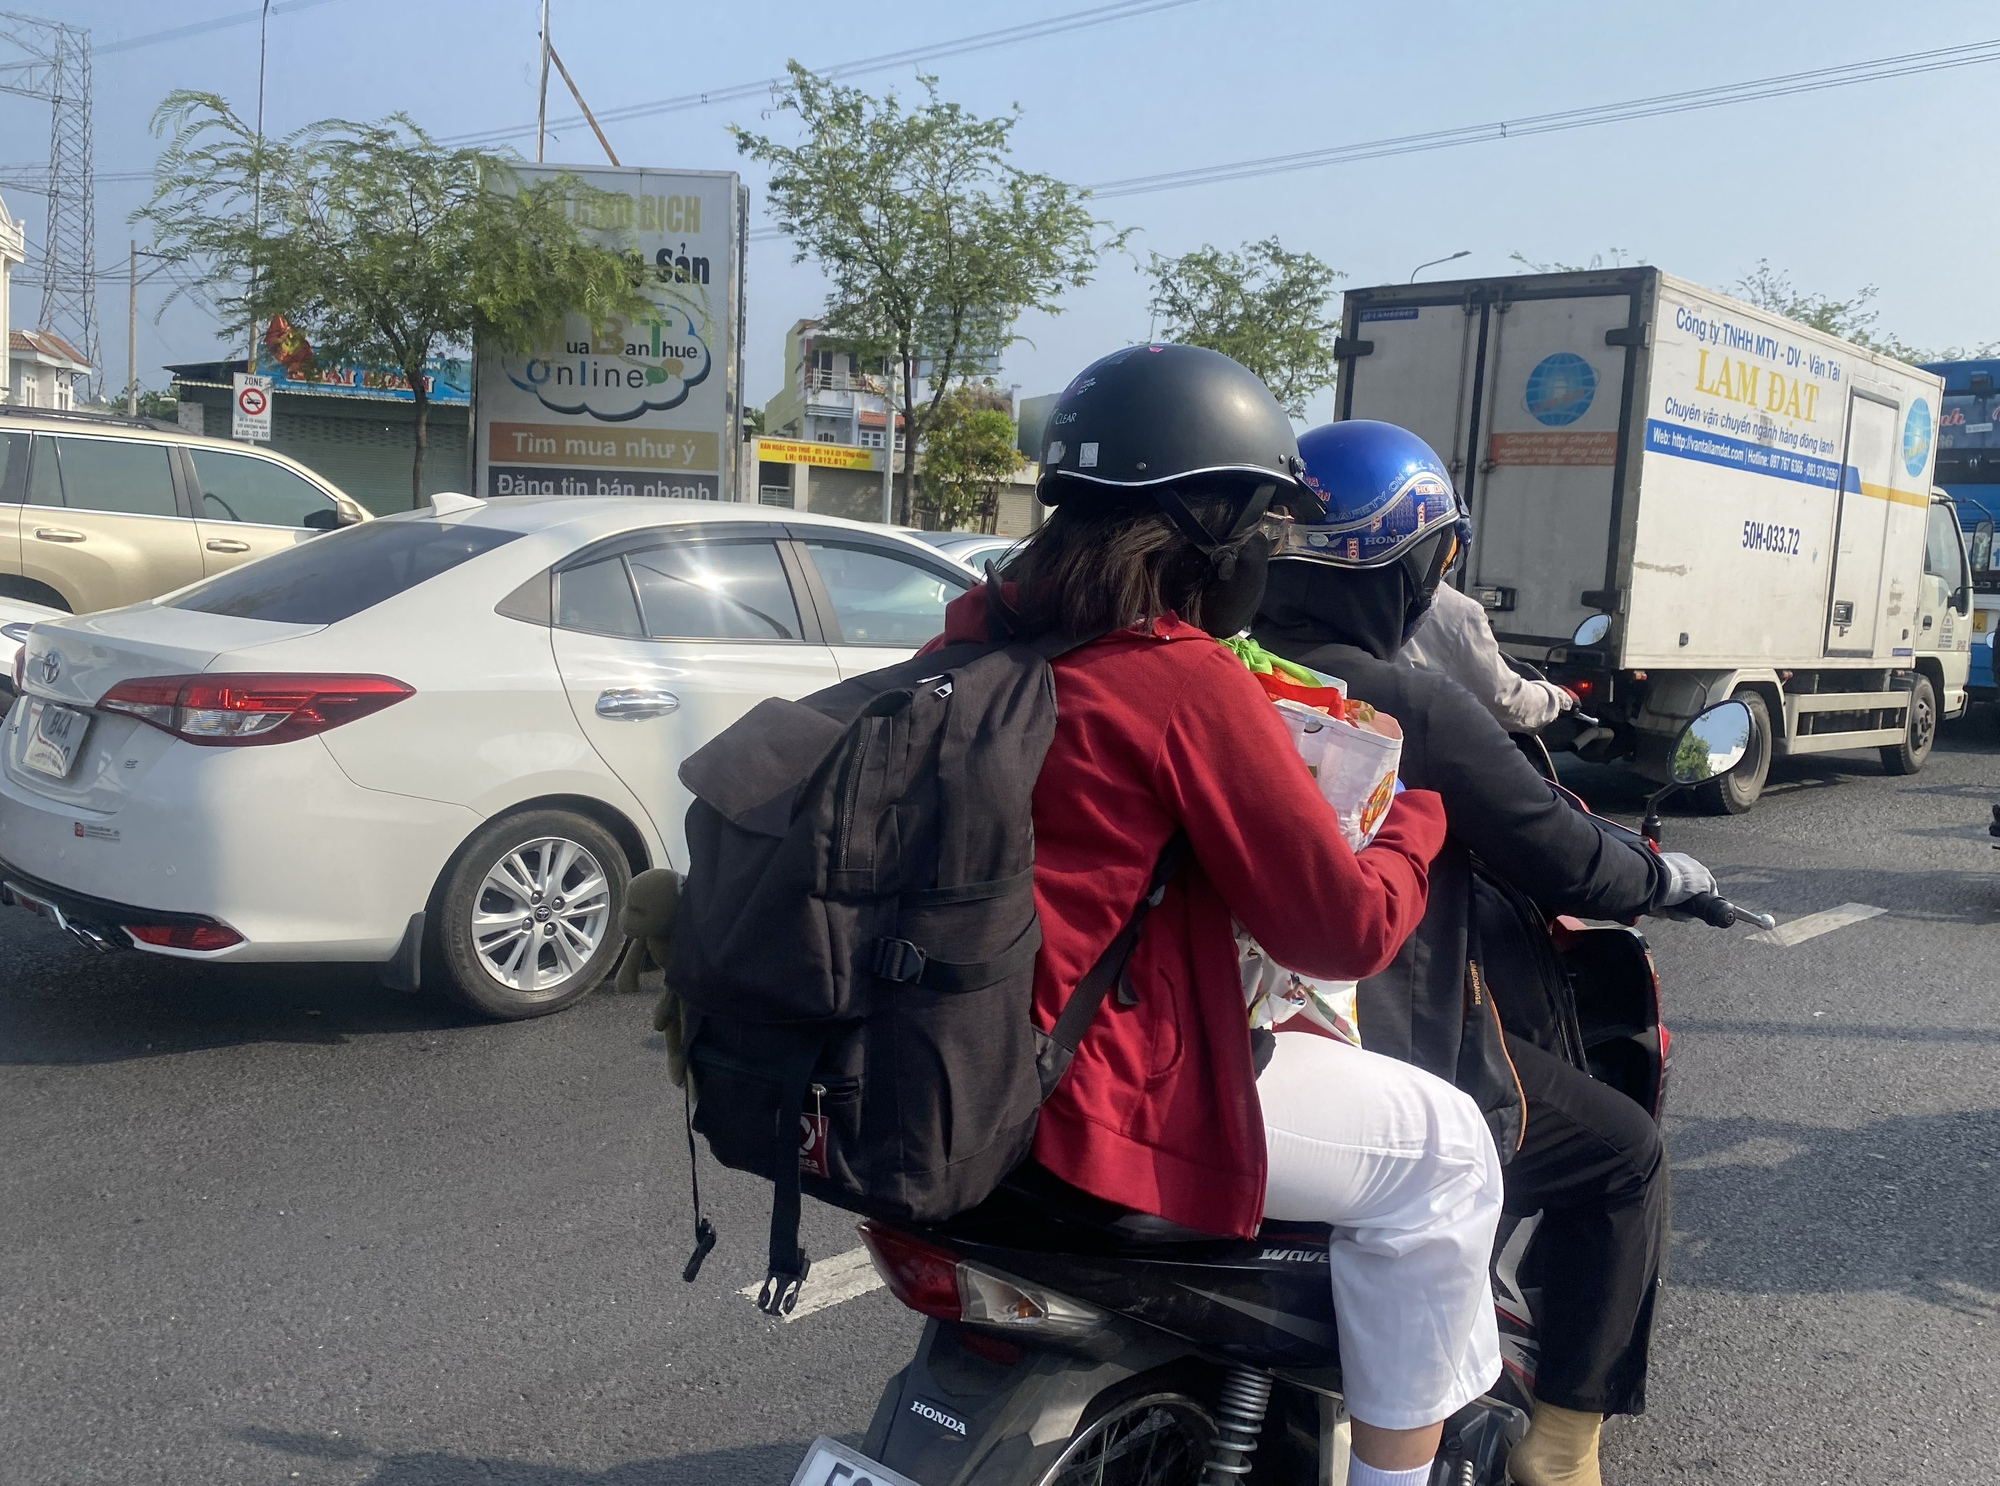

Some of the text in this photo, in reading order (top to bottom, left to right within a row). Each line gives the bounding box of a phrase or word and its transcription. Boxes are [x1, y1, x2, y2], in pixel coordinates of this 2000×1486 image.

[656, 242, 710, 285] Sản
[1676, 306, 1707, 342] Công
[1709, 320, 1721, 346] ty
[1723, 323, 1754, 353] TNHH
[1755, 334, 1779, 361] MTV
[1786, 346, 1802, 368] DV
[1809, 352, 1826, 380] Vận
[244, 376, 263, 387] ZONE
[526, 358, 645, 389] Online
[1665, 397, 1701, 422] Chuyên
[1765, 371, 1820, 427] ĐẠT
[1055, 412, 1077, 425] CLEAR
[512, 432, 696, 465] Tìm mua như ý
[1653, 427, 1671, 446] Web:
[561, 476, 589, 497] tin
[596, 477, 635, 498] bán
[1326, 492, 1387, 522] SAFETY
[1388, 472, 1406, 493] ON
[1363, 534, 1409, 545] HOND
[1742, 520, 1800, 555] 50H-033.72
[910, 1400, 967, 1435] HONDA
